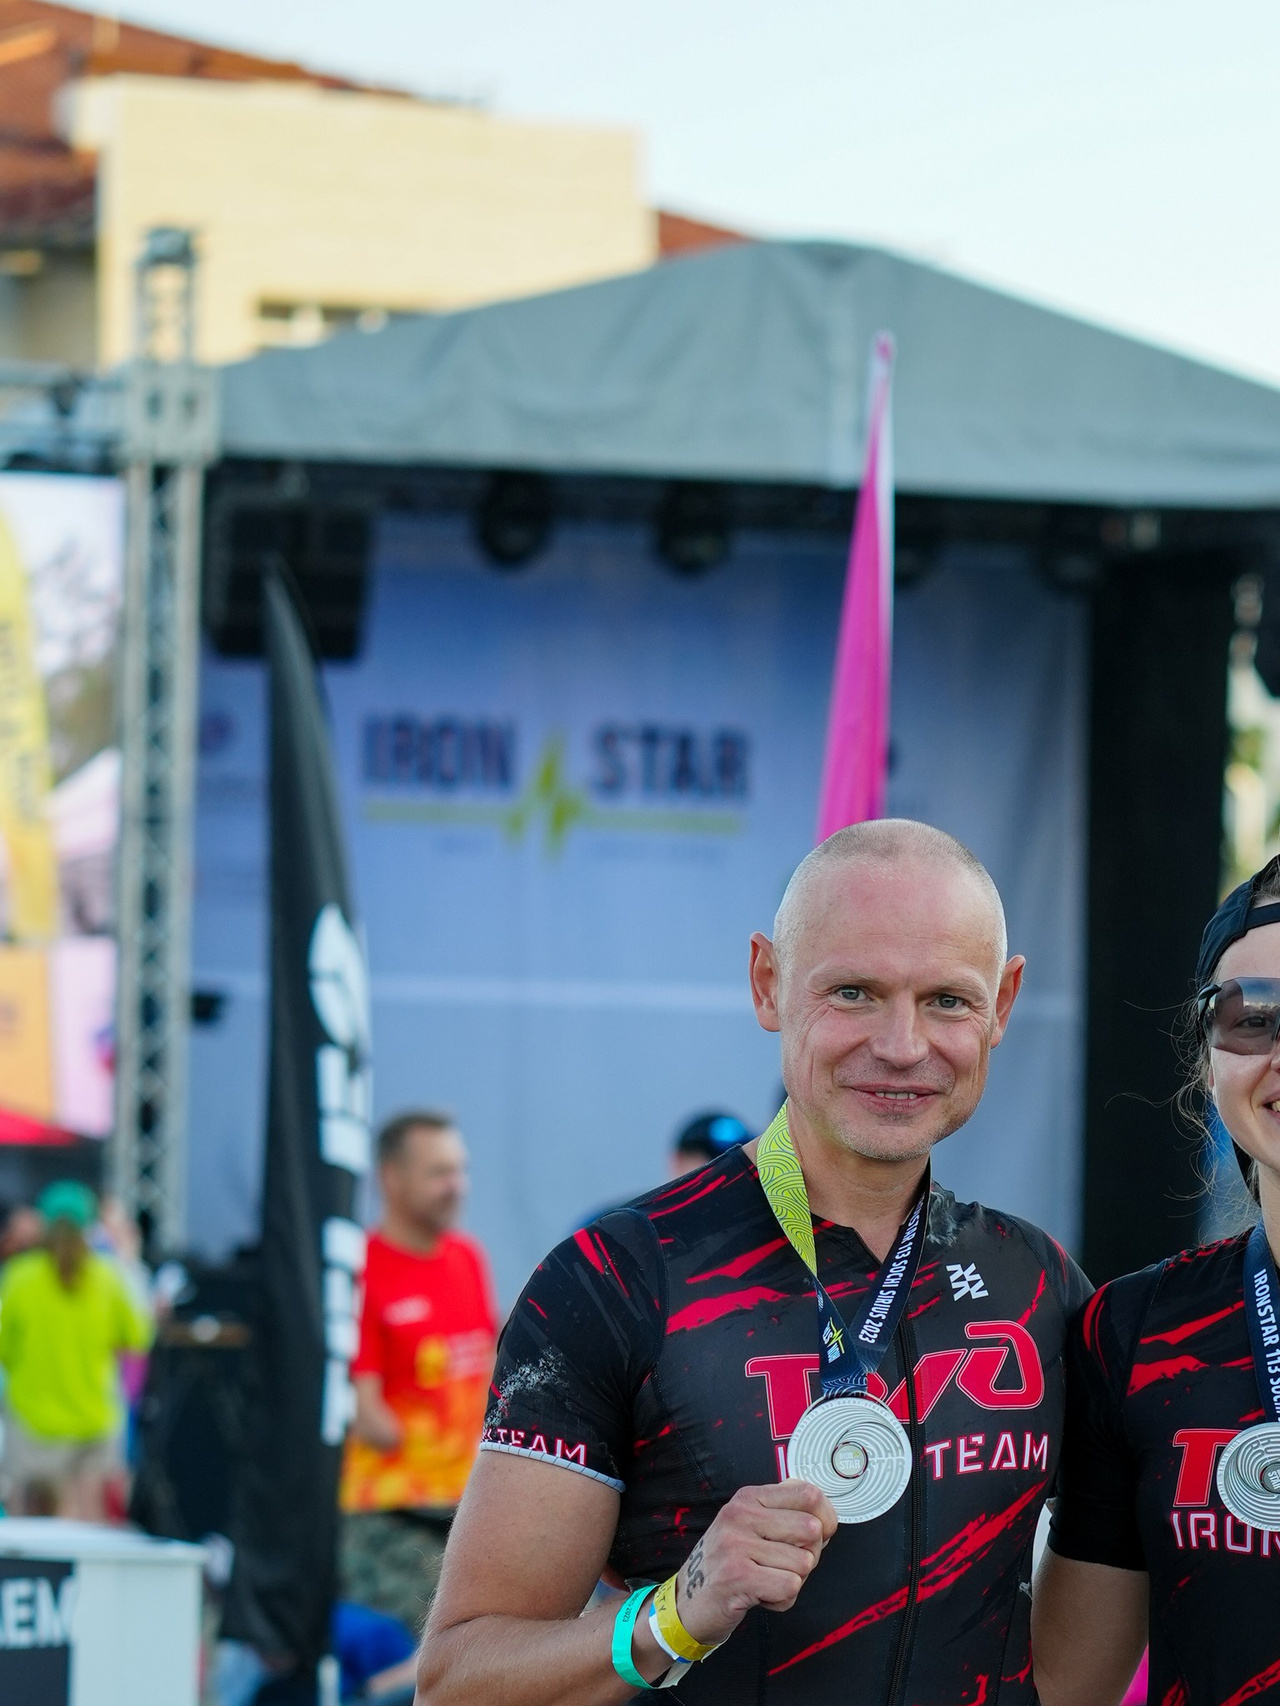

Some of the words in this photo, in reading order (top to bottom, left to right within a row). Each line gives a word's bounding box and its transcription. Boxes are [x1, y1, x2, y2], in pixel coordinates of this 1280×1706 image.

[363, 714, 515, 788] IRON
[595, 723, 748, 798] STAR
[901, 1191, 927, 1245] NSTAR
[895, 1242, 913, 1260] 113
[882, 1258, 908, 1288] SOCHI
[874, 1290, 896, 1320] SIRIUS
[1254, 1268, 1280, 1347] IRONSTAR
[858, 1318, 881, 1344] 2023
[497, 1428, 586, 1466] TEAM
[926, 1430, 1049, 1480] TEAM
[839, 1459, 861, 1470] STAR
[0, 1577, 77, 1648] EM
[622, 1607, 631, 1623] 2023
